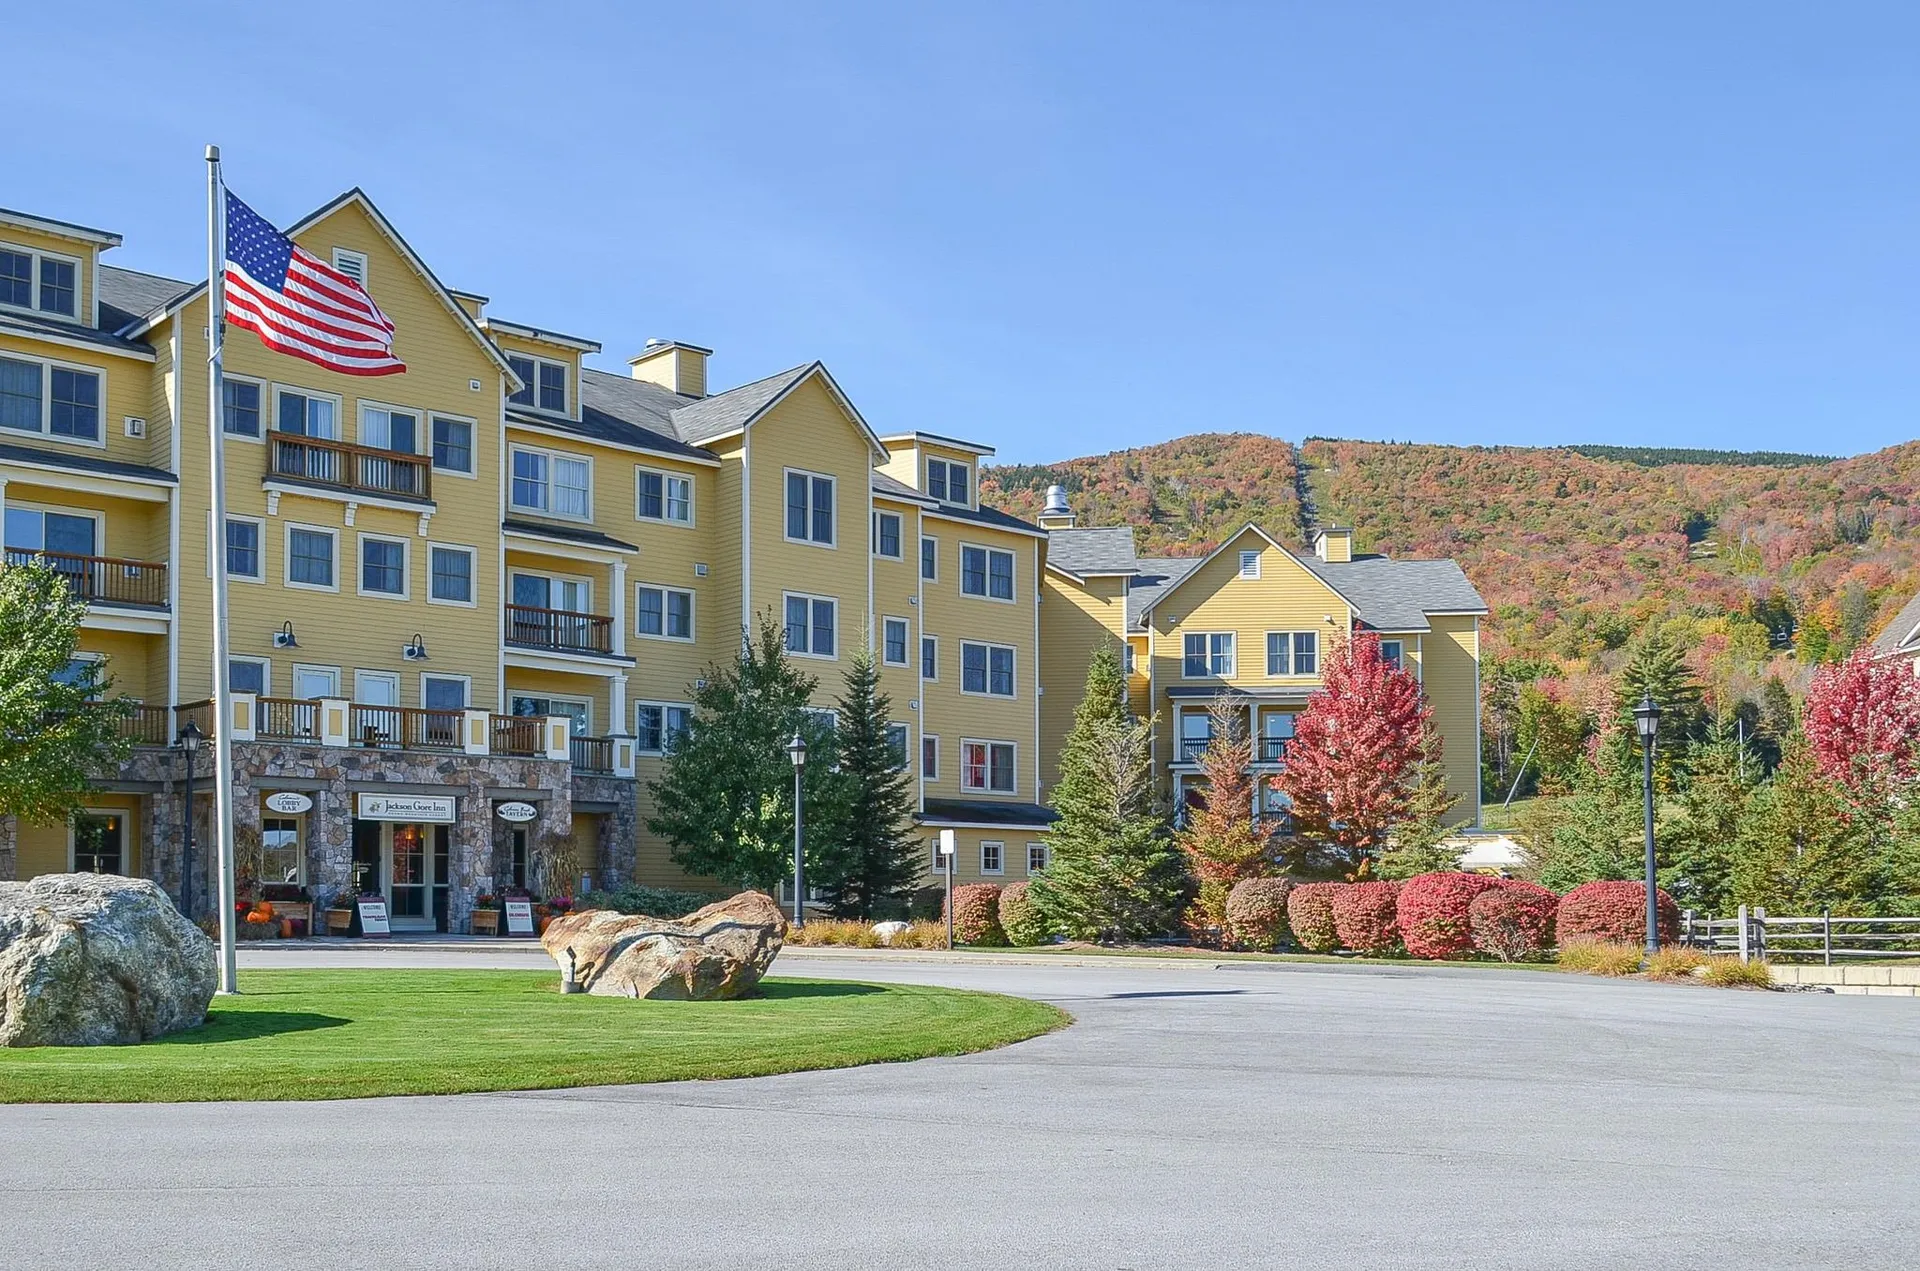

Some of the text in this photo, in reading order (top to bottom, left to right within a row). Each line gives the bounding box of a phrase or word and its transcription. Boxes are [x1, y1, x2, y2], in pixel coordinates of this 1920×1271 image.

[384, 800, 446, 813] Jackson Gore Inn
